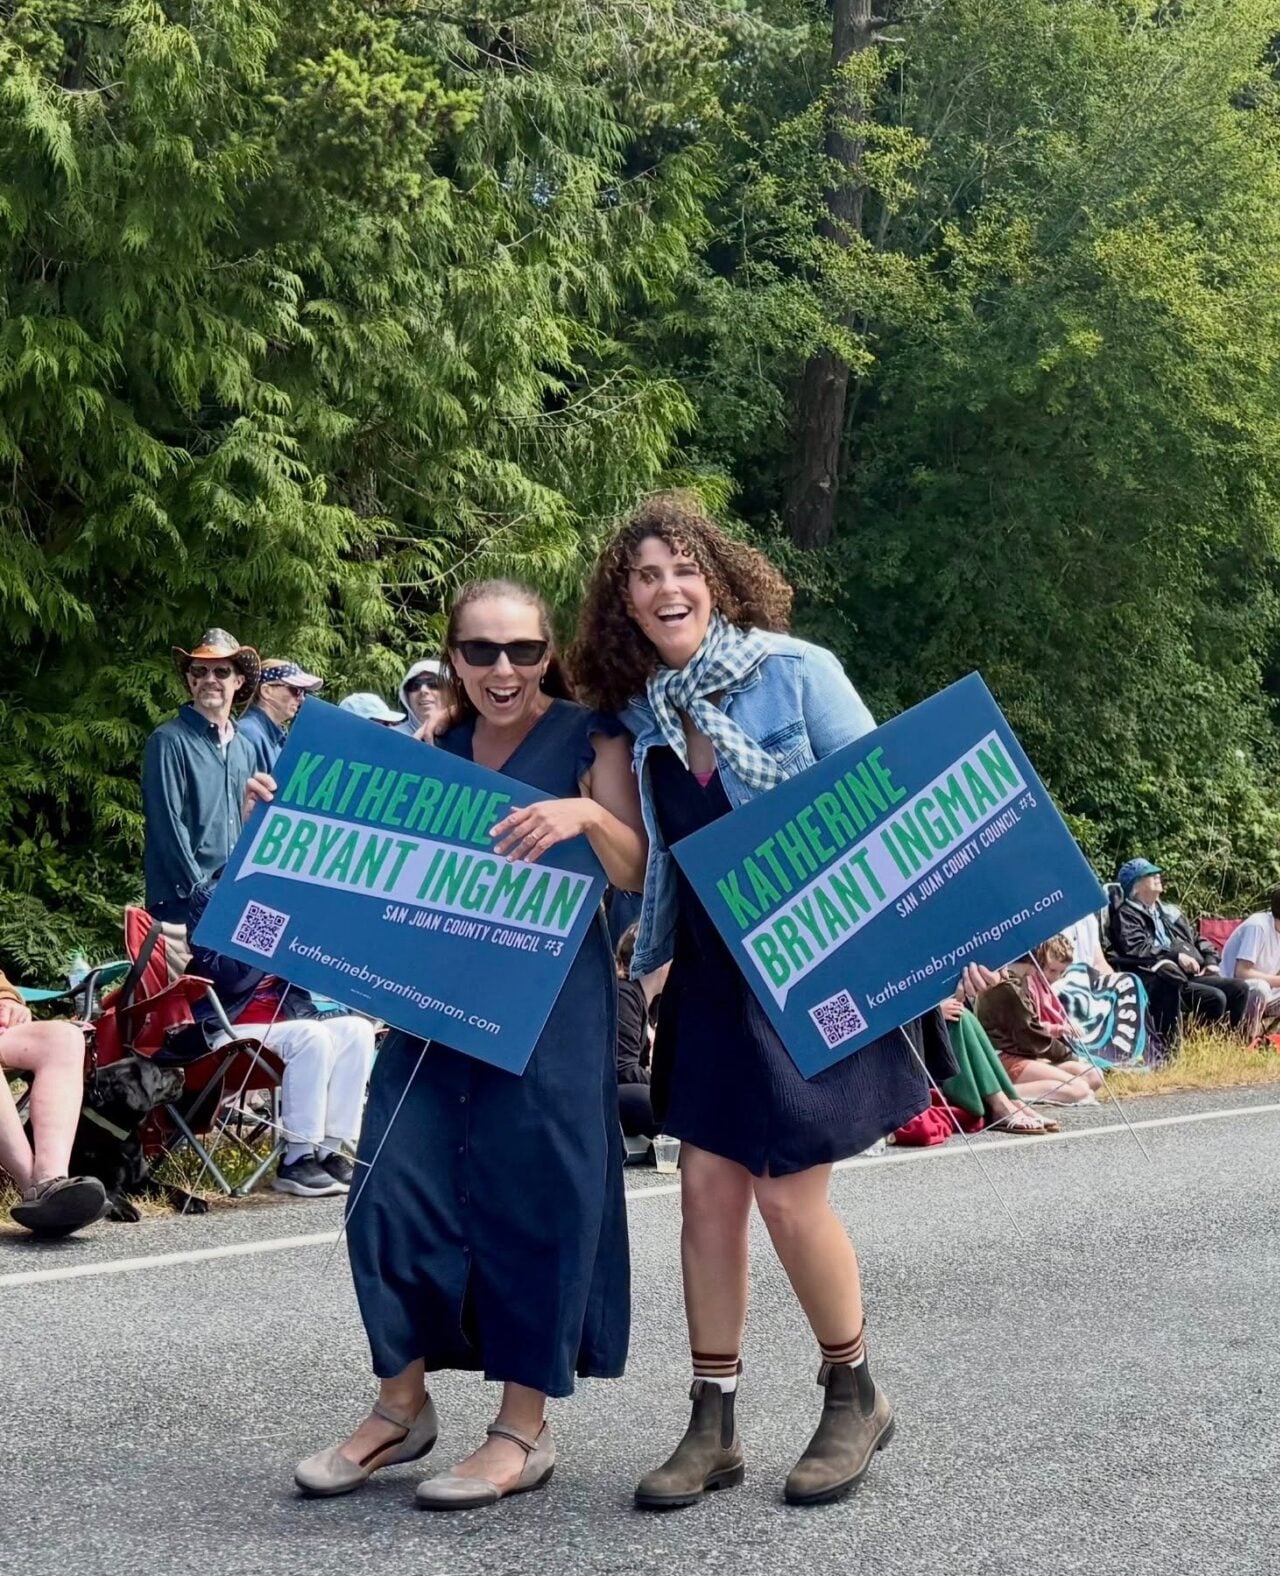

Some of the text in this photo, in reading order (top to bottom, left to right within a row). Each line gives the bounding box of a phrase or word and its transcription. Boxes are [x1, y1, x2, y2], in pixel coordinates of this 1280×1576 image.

[281, 751, 511, 846] KATHERINE
[716, 745, 908, 930] KATHERINE
[895, 792, 1038, 919] SAN JUAN COUNTY COUNCIL #3
[252, 813, 587, 931] BRYANT INGMAN
[751, 739, 1020, 990] BRYANT INGMAN
[288, 936, 502, 1035] katherinebryantingman.com
[382, 904, 566, 958] SAN JUAN COUNTY COUNCIL #3
[866, 890, 1064, 1010] katherinebryantingman.com
